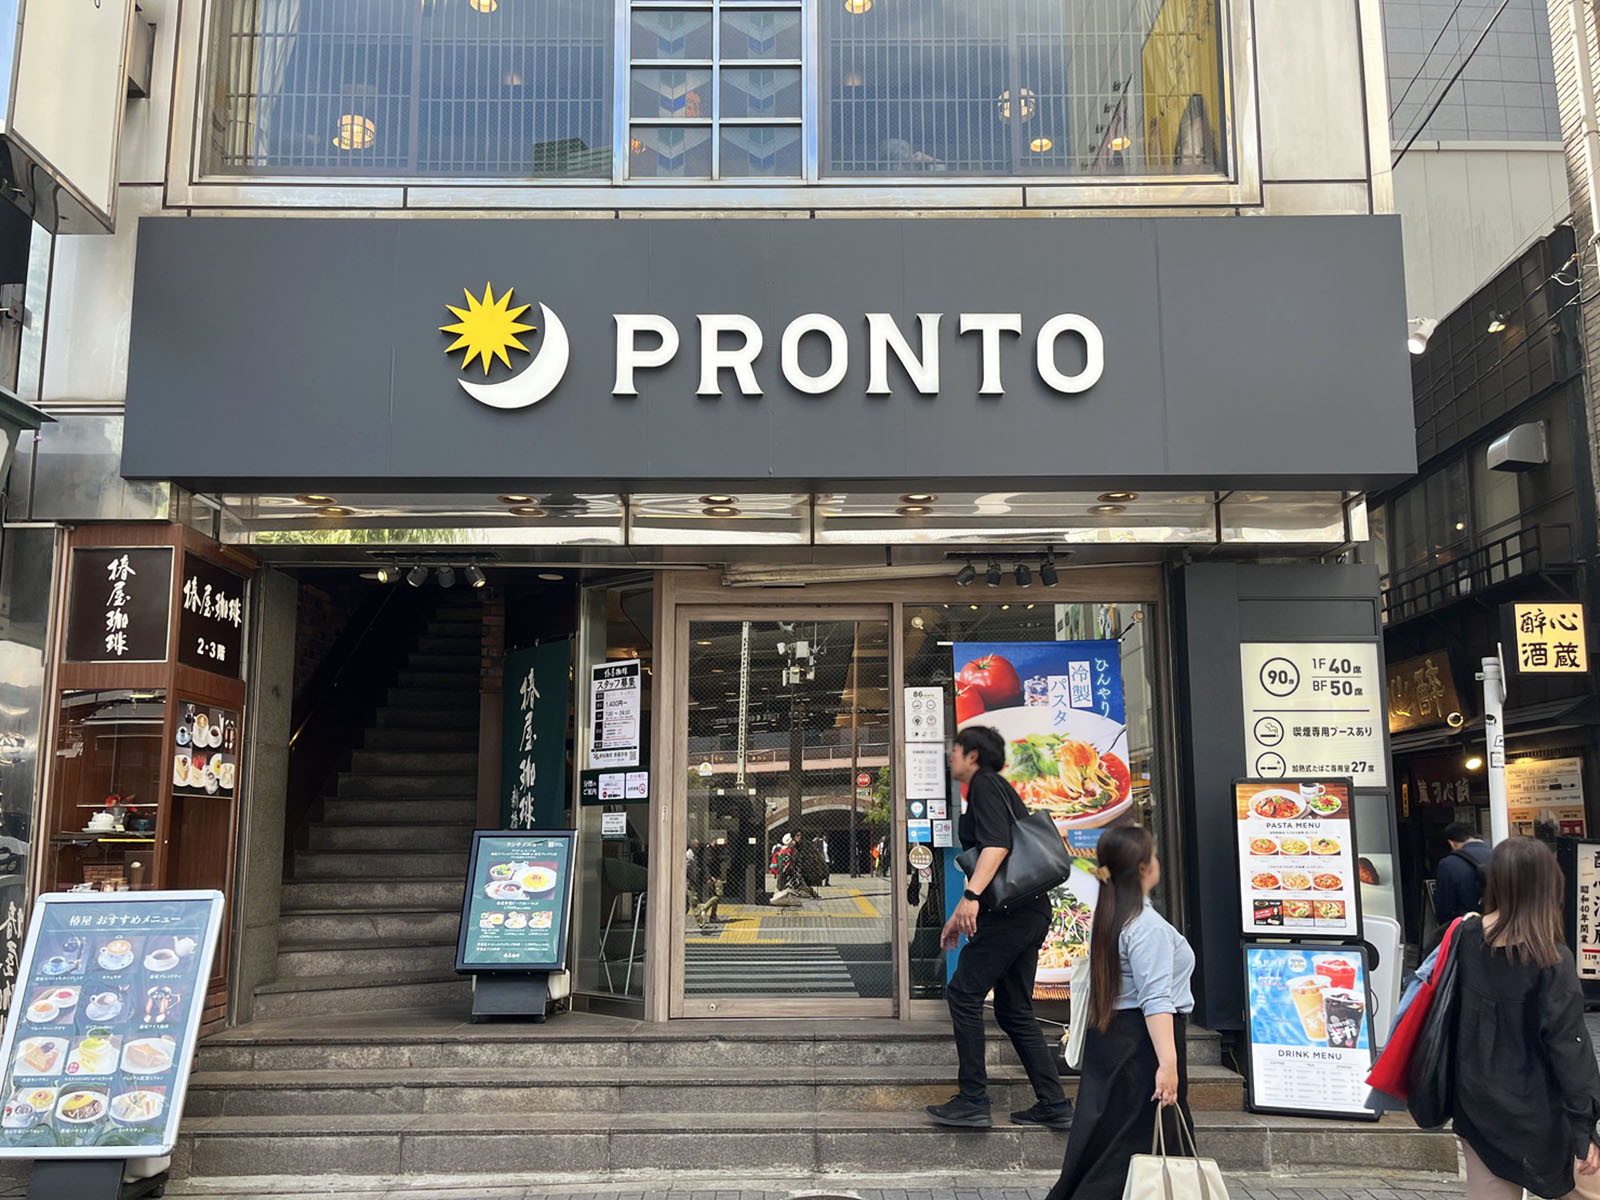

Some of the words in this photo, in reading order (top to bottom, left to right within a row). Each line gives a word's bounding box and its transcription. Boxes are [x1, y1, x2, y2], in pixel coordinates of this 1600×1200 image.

[611, 313, 1105, 395] PRONTO
[105, 554, 136, 656] 椿屋珈琲
[183, 575, 242, 628] 椿屋珈琲
[1520, 608, 1578, 638] 酔心
[1312, 658, 1326, 669] 1F
[1521, 642, 1581, 668] 酒蔵
[1071, 664, 1092, 703] 冷製
[1094, 657, 1112, 720] ひんやり
[1313, 680, 1327, 691] BF
[1050, 678, 1068, 727] パスタ
[518, 667, 541, 830] 椿屋珈琲
[1292, 726, 1373, 738] 喫煙専用ブースあり
[96, 914, 182, 926] おすすめメニュー
[1278, 1049, 1309, 1059] DRINK
[1313, 1051, 1343, 1061] MENU
